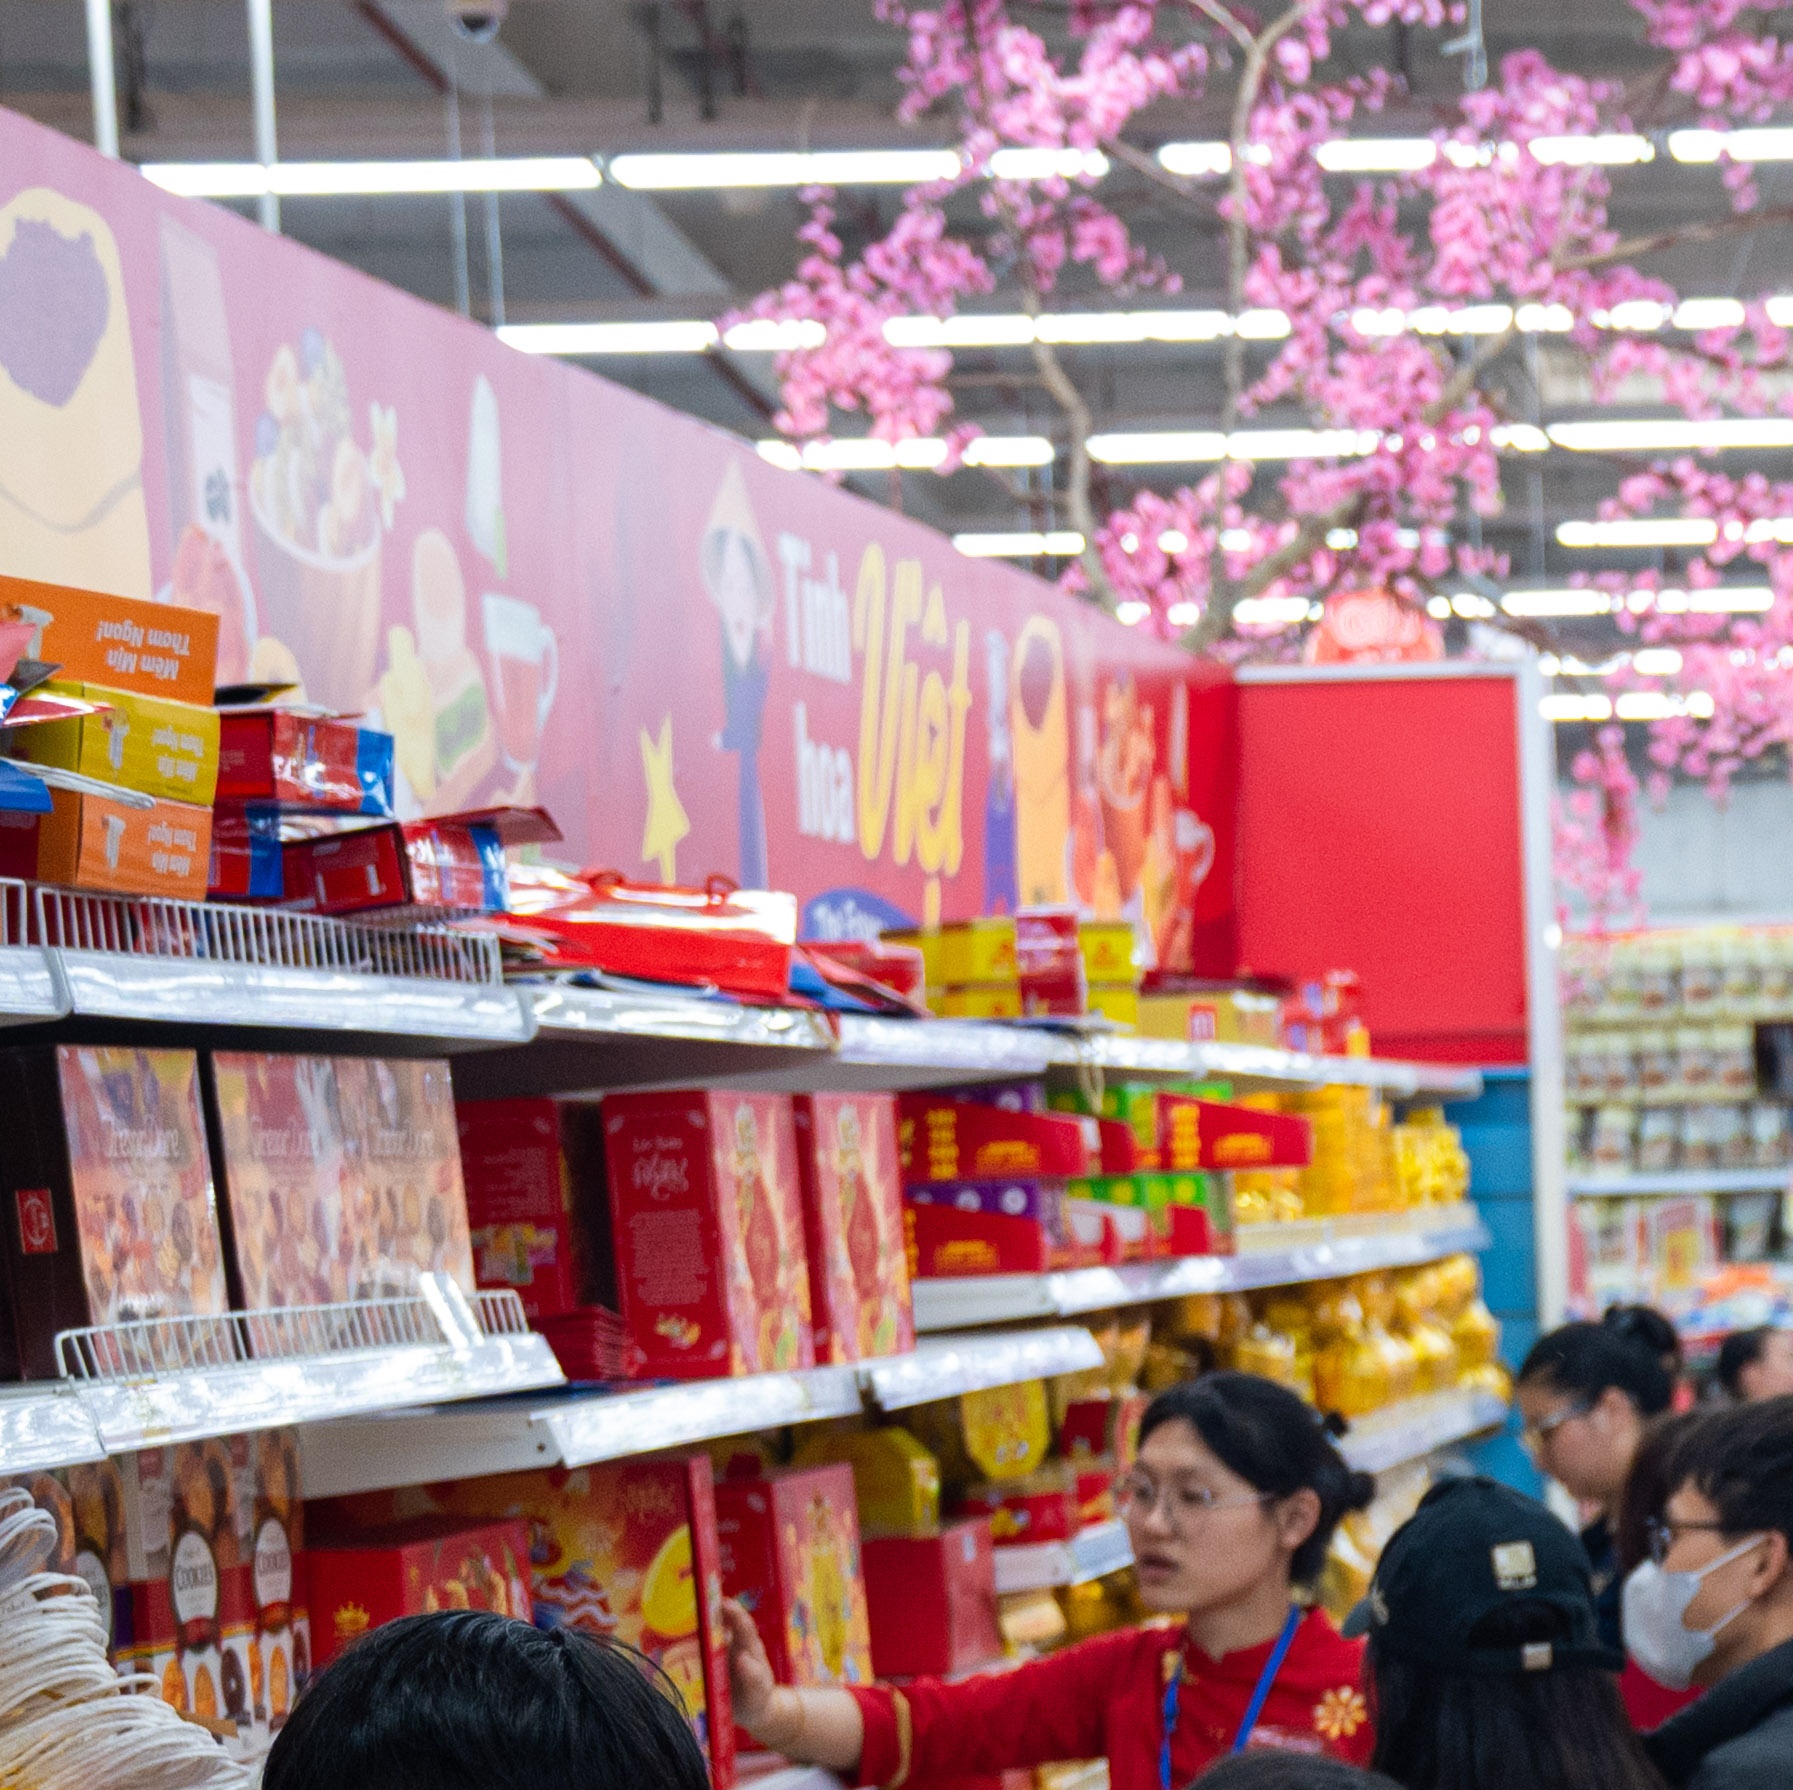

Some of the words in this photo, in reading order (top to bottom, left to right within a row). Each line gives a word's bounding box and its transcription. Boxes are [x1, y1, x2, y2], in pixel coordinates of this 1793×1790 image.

[779, 531, 852, 684] Tinh
[794, 702, 855, 844] hoa
[854, 542, 972, 934] Việt
